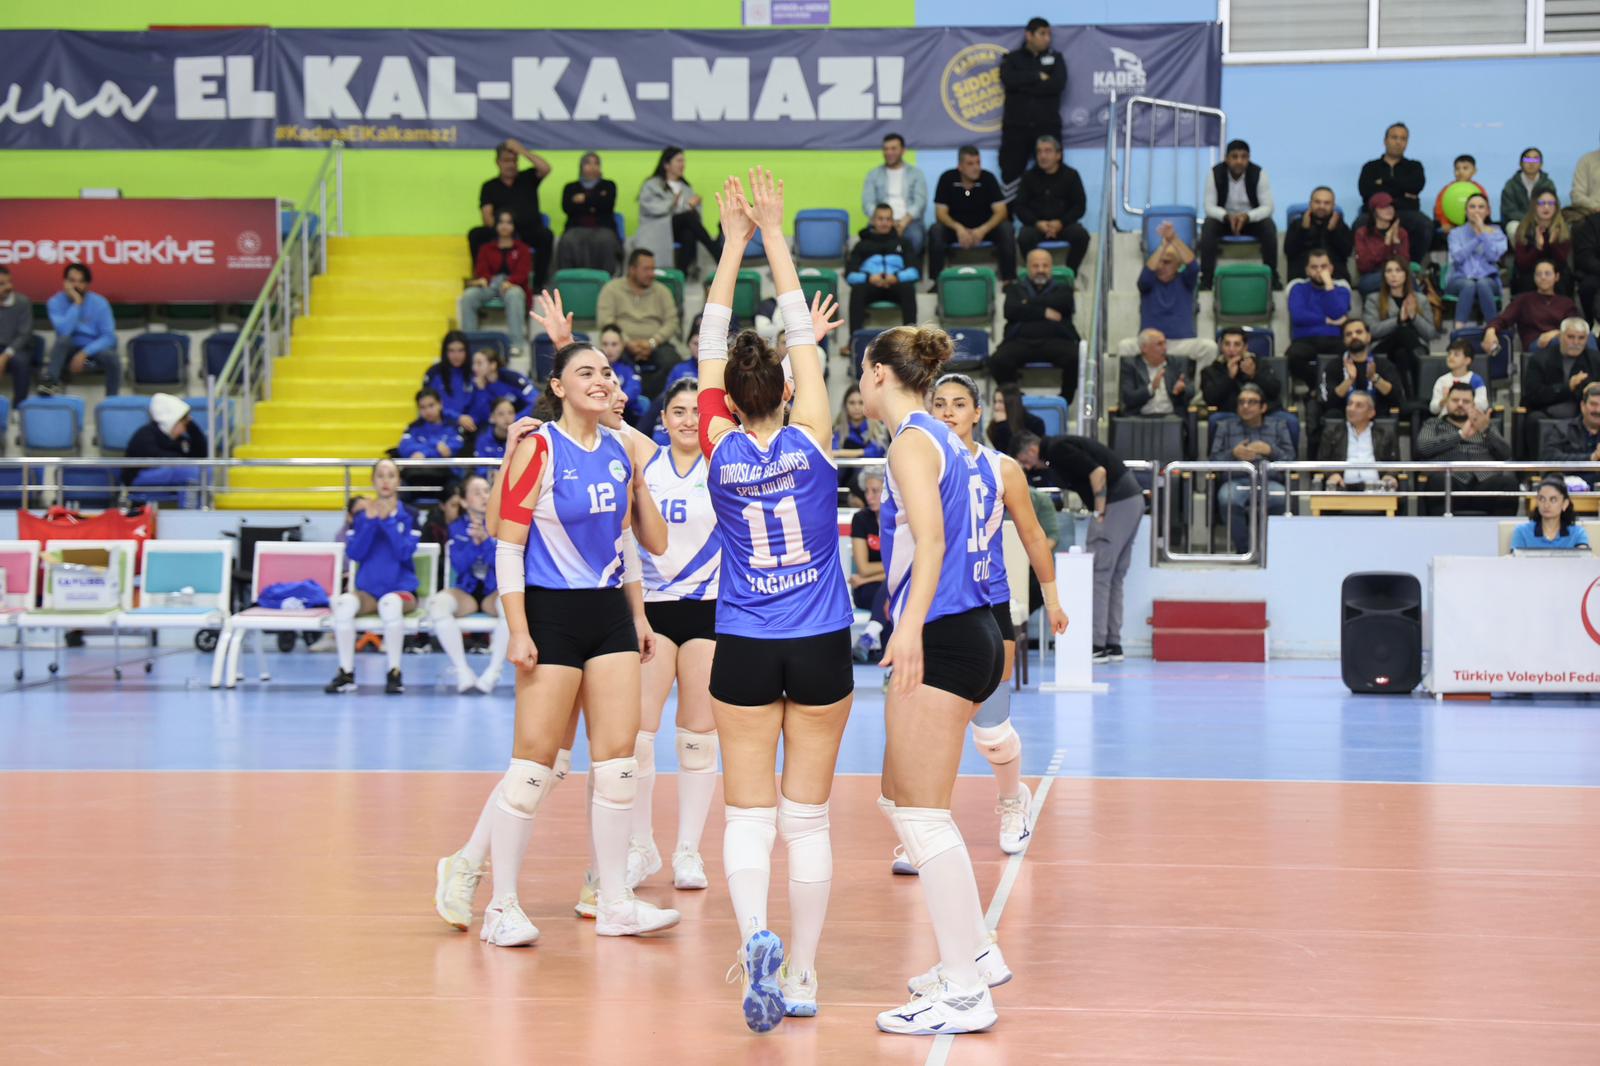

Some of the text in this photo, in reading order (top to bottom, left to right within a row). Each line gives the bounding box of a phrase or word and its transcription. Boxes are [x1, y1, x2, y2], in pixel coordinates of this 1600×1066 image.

[173, 55, 276, 119] EL
[303, 55, 905, 120] KAL-KA-MAZ!
[1093, 71, 1147, 87] KADES
[587, 482, 616, 514] 12
[660, 499, 687, 524] 16
[741, 495, 811, 569] 11
[746, 567, 818, 594] YAĞMUR
[1453, 670, 1504, 684] Türkiye
[1506, 671, 1566, 685] Voleybol
